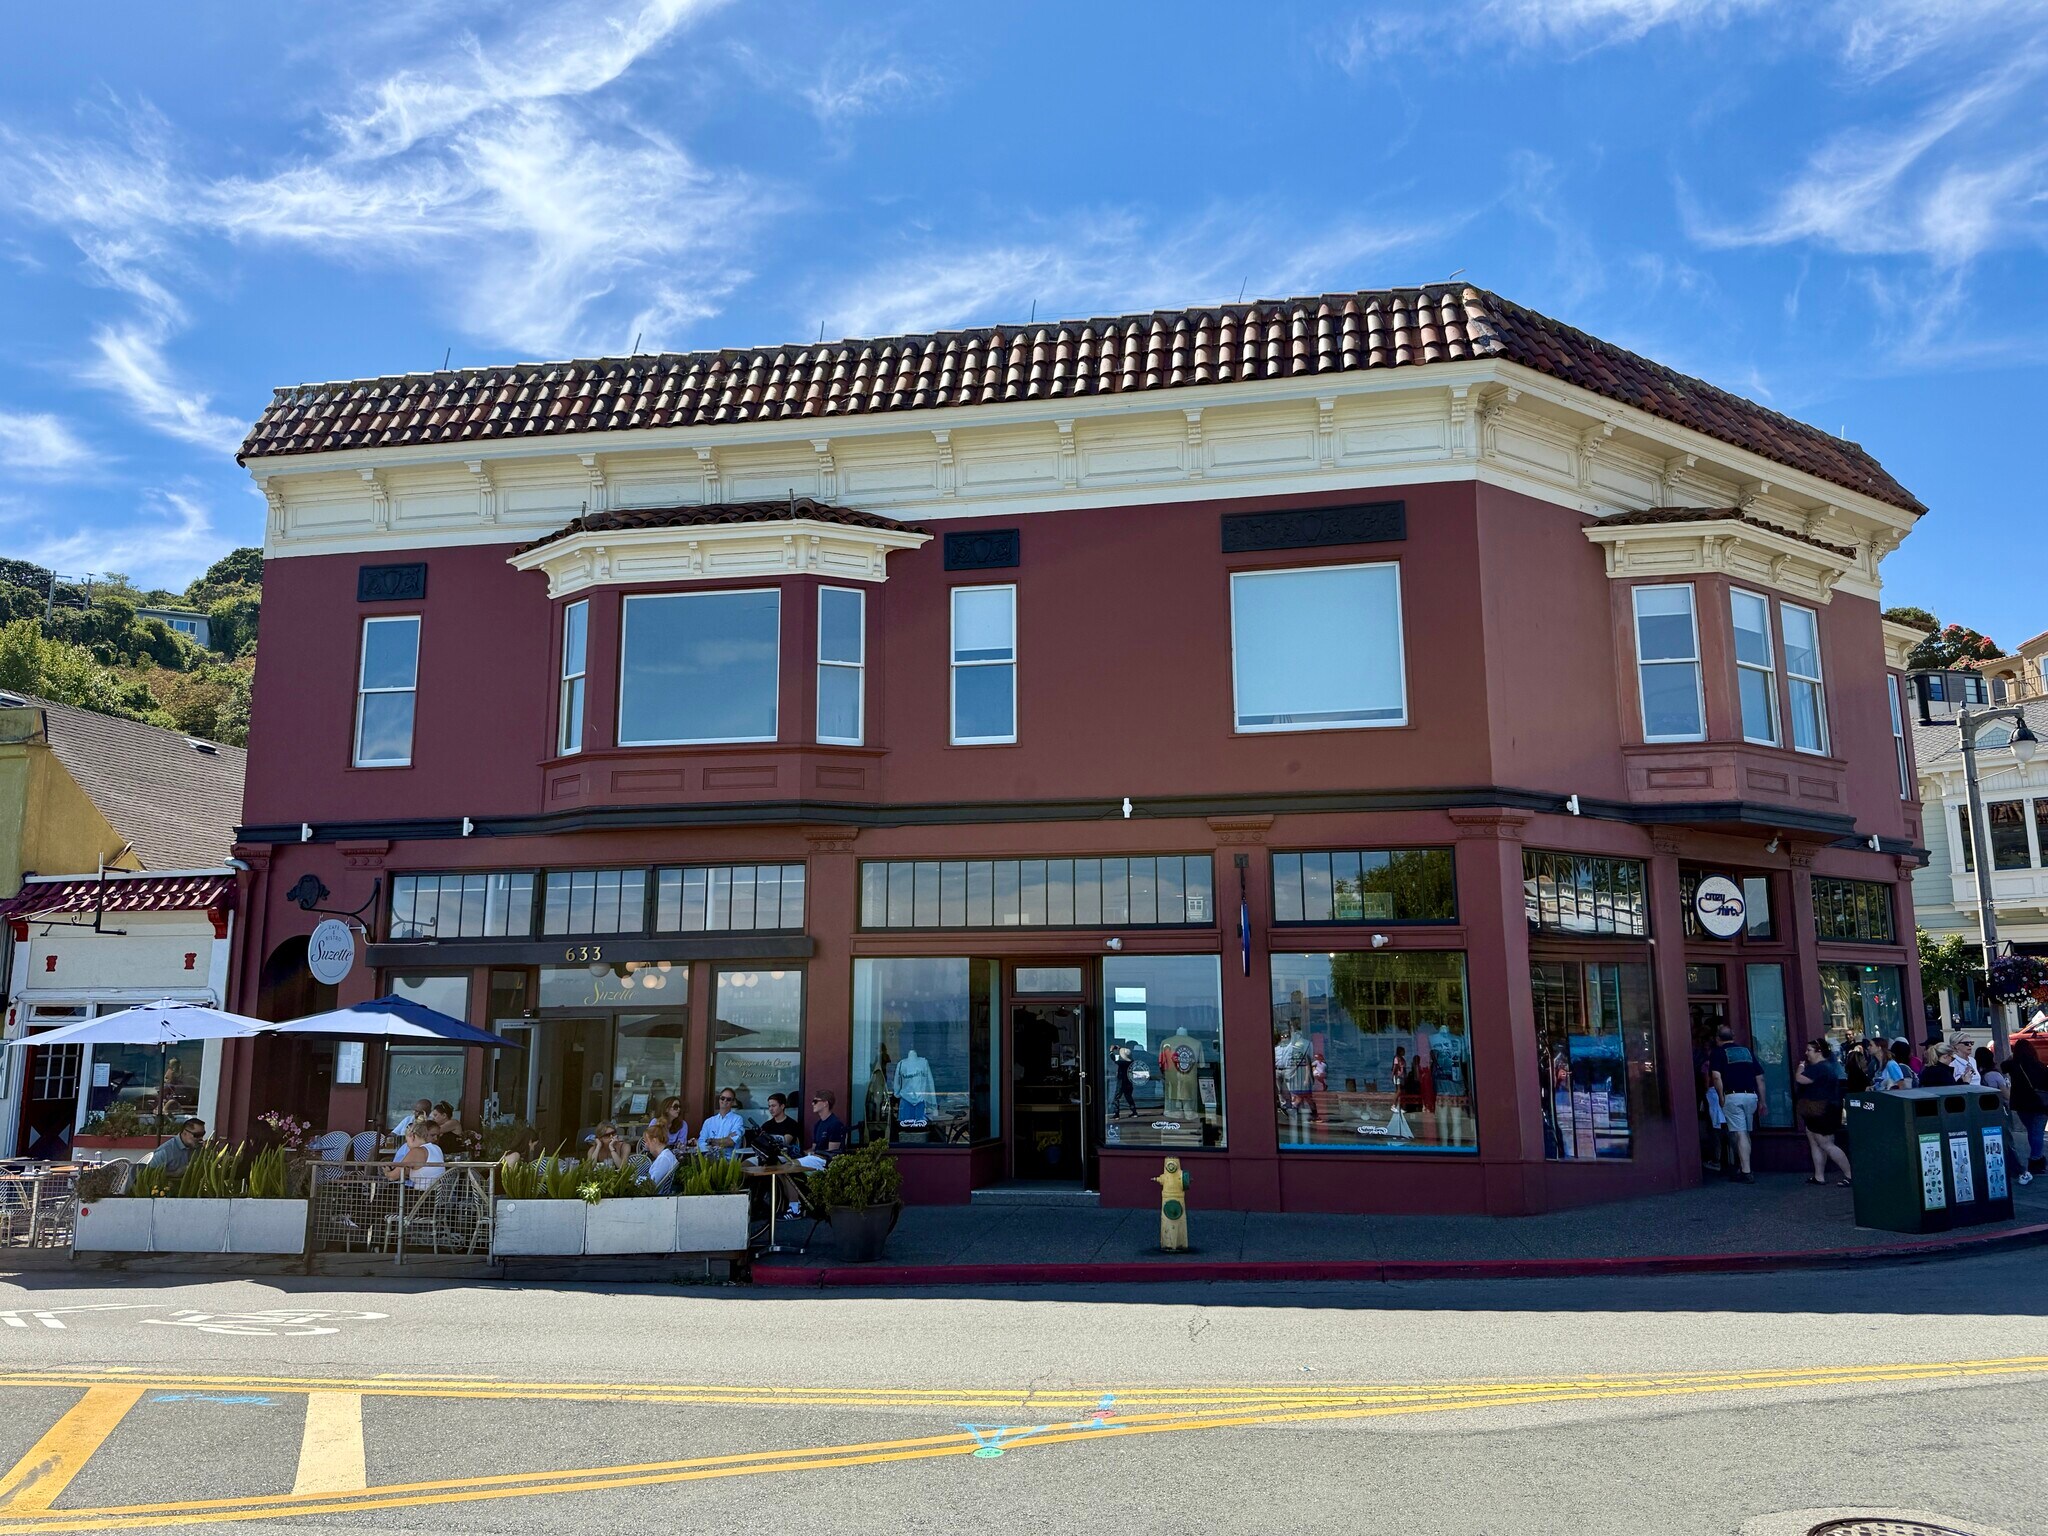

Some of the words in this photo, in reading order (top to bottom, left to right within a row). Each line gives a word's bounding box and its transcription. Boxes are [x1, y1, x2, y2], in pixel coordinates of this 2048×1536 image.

[1705, 893, 1725, 904] crazy
[311, 940, 353, 962] Suzette
[565, 946, 602, 961] 633
[584, 980, 636, 1005] Suzette
[428, 1063, 458, 1076] Bistro
